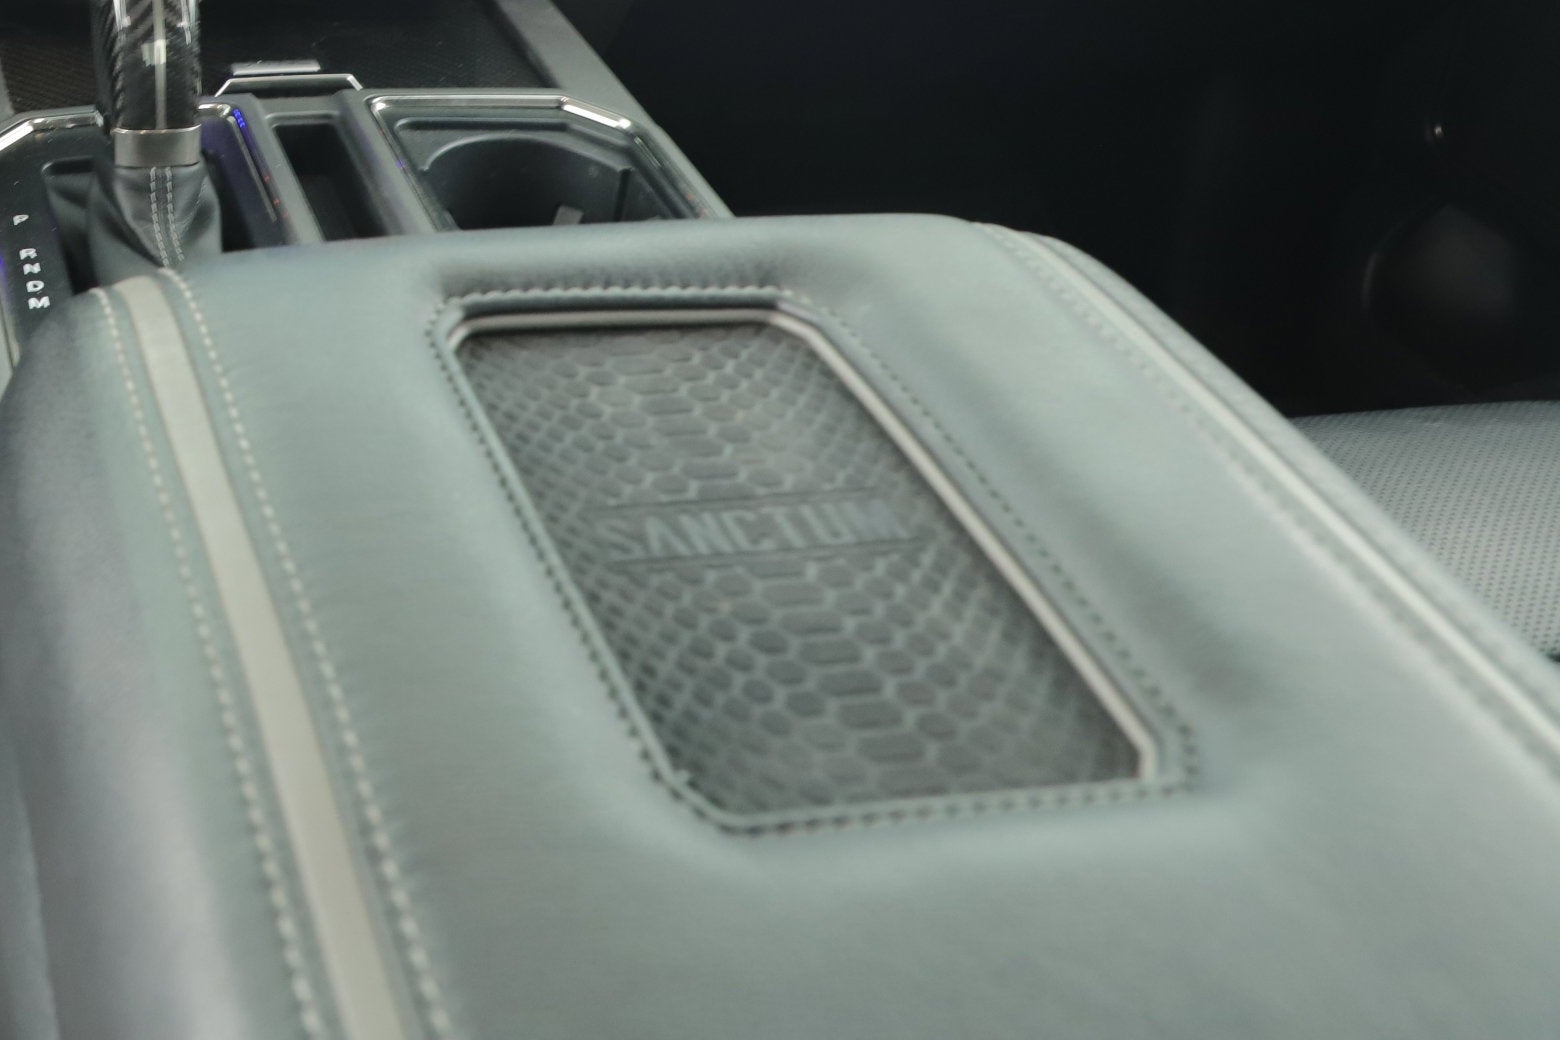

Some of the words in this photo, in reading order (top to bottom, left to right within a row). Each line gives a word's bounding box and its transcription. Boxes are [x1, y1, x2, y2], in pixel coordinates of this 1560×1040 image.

[12, 214, 29, 226] P
[19, 248, 37, 260] R
[23, 262, 41, 275] N
[26, 280, 44, 292] D
[28, 296, 50, 310] M
[593, 500, 908, 560] SANCTUM
